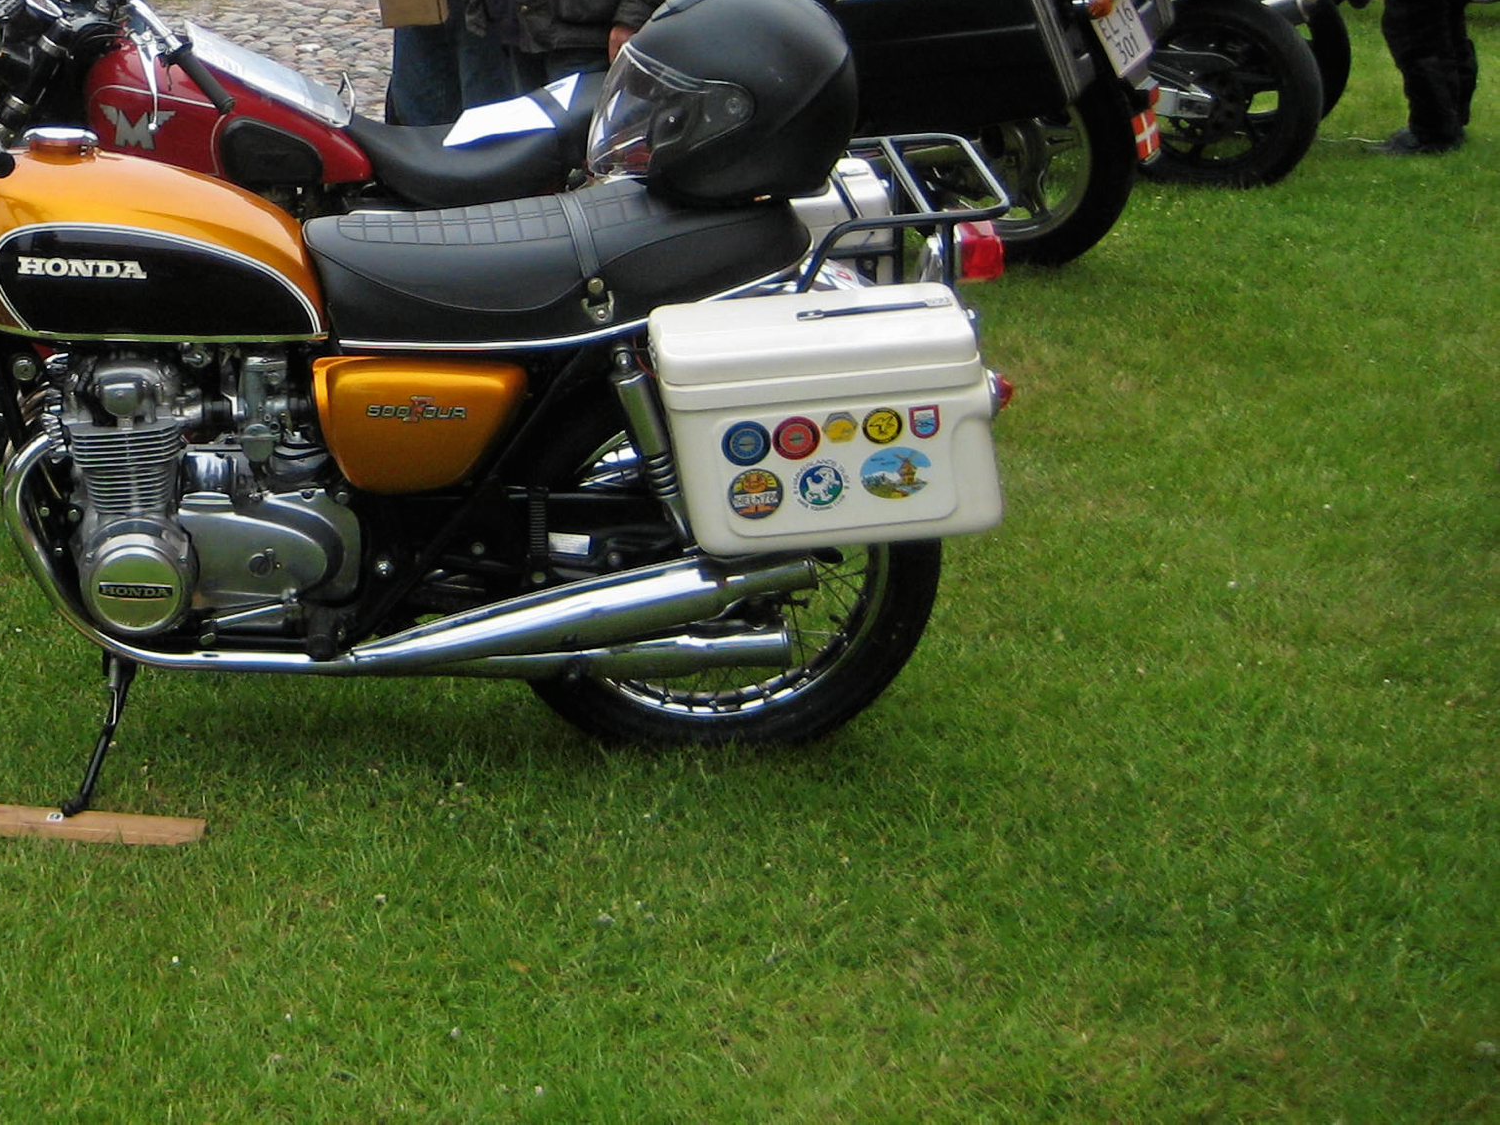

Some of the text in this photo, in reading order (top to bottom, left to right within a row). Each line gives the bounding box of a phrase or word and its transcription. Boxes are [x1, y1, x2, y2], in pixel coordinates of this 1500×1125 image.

[1098, 1, 1134, 41] EL 16
[1115, 32, 1140, 65] 301
[17, 256, 148, 280] HONDA
[100, 585, 170, 597] HONDA
